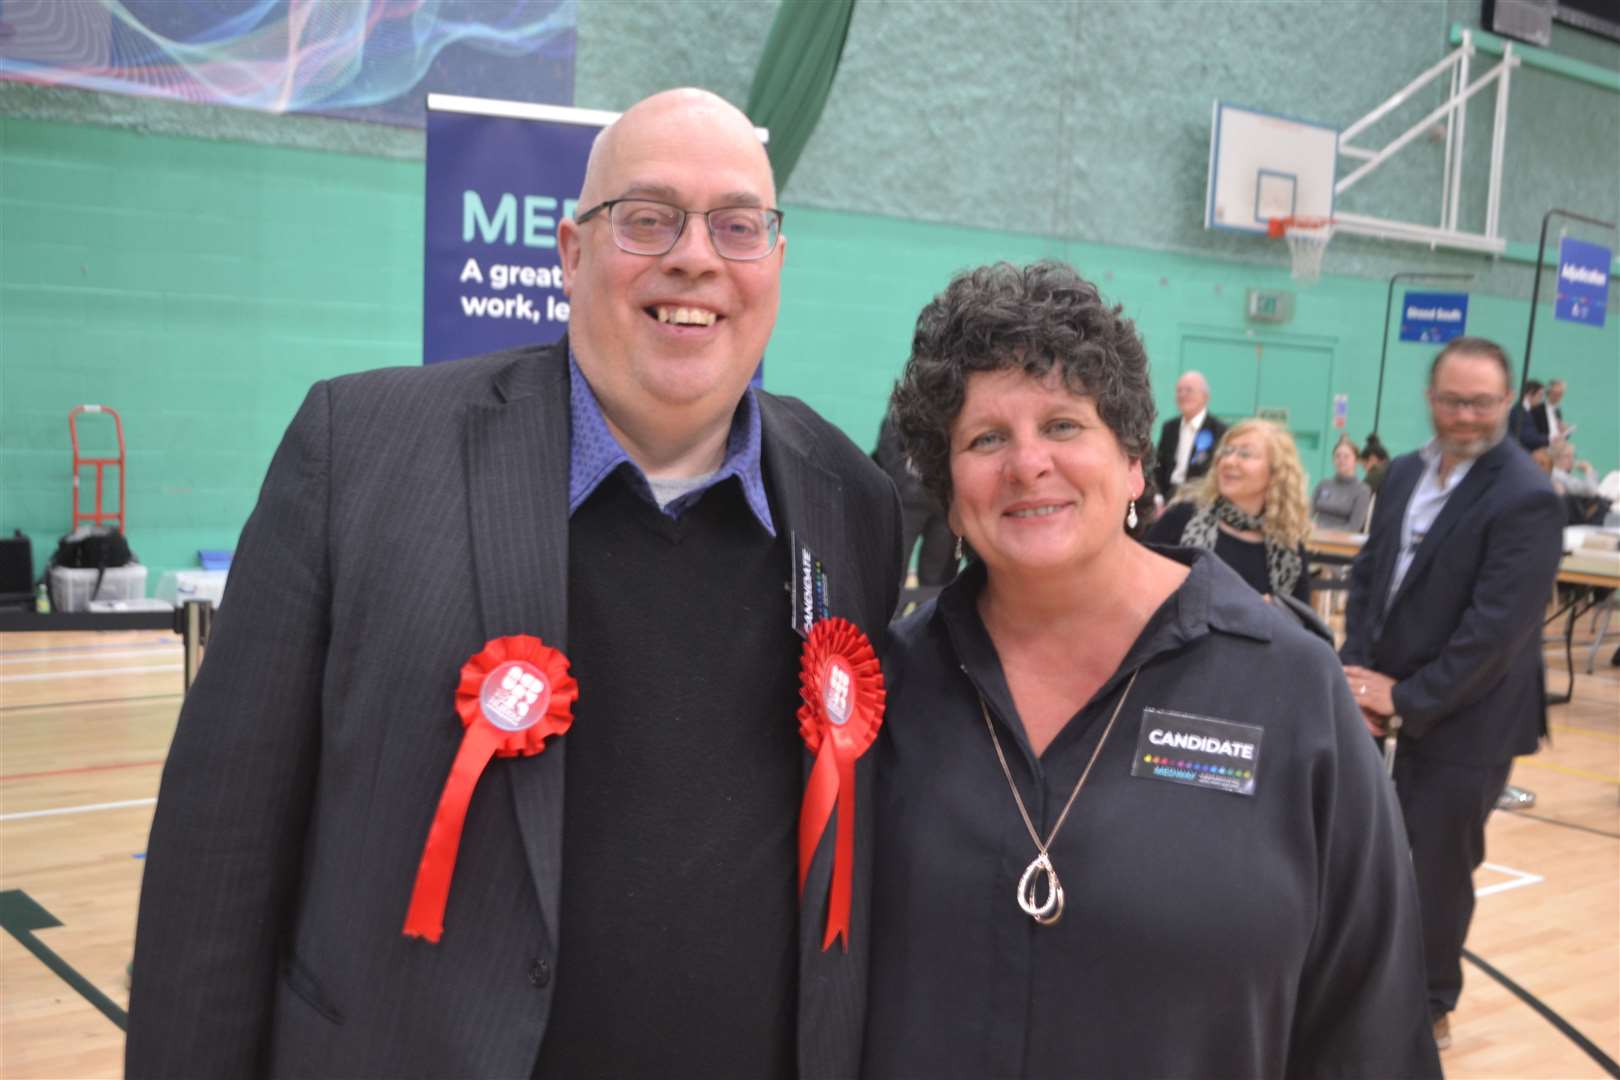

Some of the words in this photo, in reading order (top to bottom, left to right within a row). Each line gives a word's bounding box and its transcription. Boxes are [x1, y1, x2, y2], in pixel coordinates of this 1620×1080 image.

[460, 258, 484, 284] A
[489, 263, 563, 290] great
[460, 293, 541, 324] work,
[1148, 728, 1255, 760] CANDIDATE
